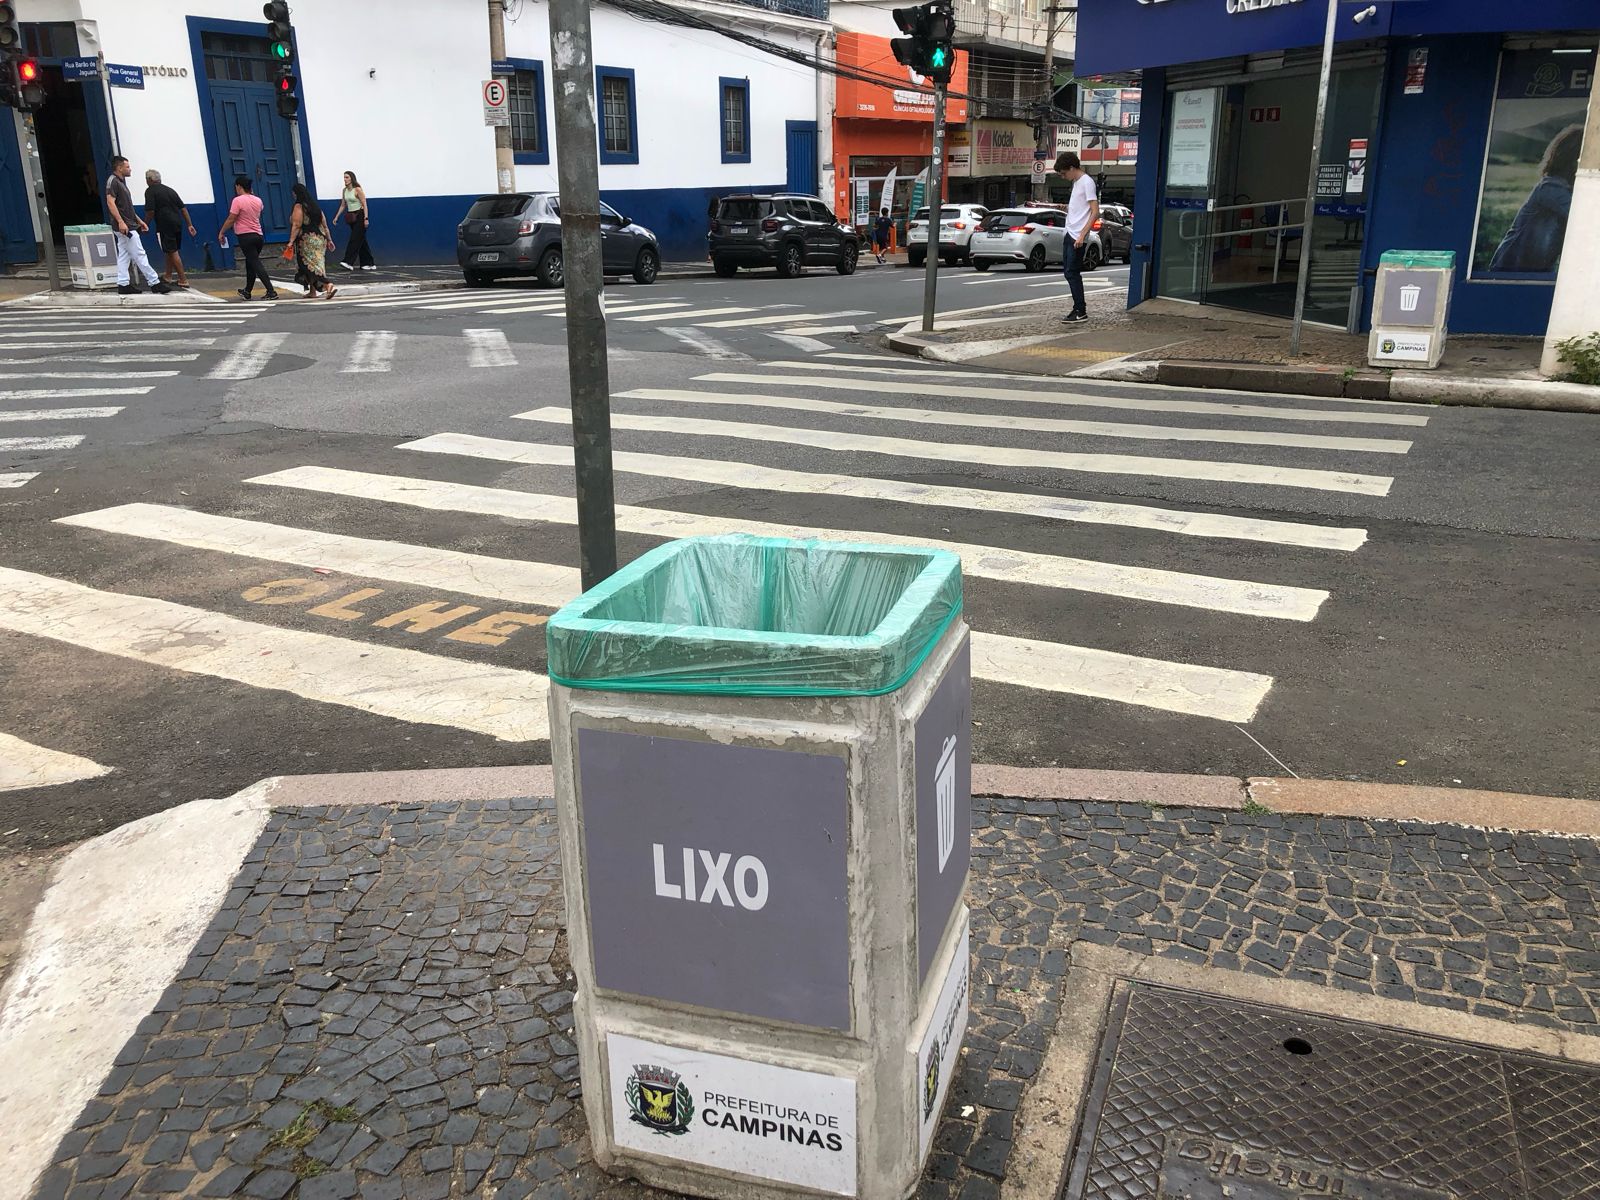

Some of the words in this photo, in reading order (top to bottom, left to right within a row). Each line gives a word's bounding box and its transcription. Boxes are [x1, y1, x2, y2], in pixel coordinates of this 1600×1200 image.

[120, 68, 138, 76] General
[125, 76, 141, 84] Osório
[490, 86, 499, 101] E
[1058, 125, 1080, 136] WALDIR
[992, 131, 1015, 147] Kodak
[1057, 138, 1078, 148] PHOTO
[1036, 163, 1042, 171] E
[240, 577, 552, 647] OLHE
[652, 842, 769, 911] LIXO
[704, 1091, 811, 1124] PREFEITURA
[815, 1113, 839, 1129] DE
[701, 1107, 843, 1152] CAMPINAS
